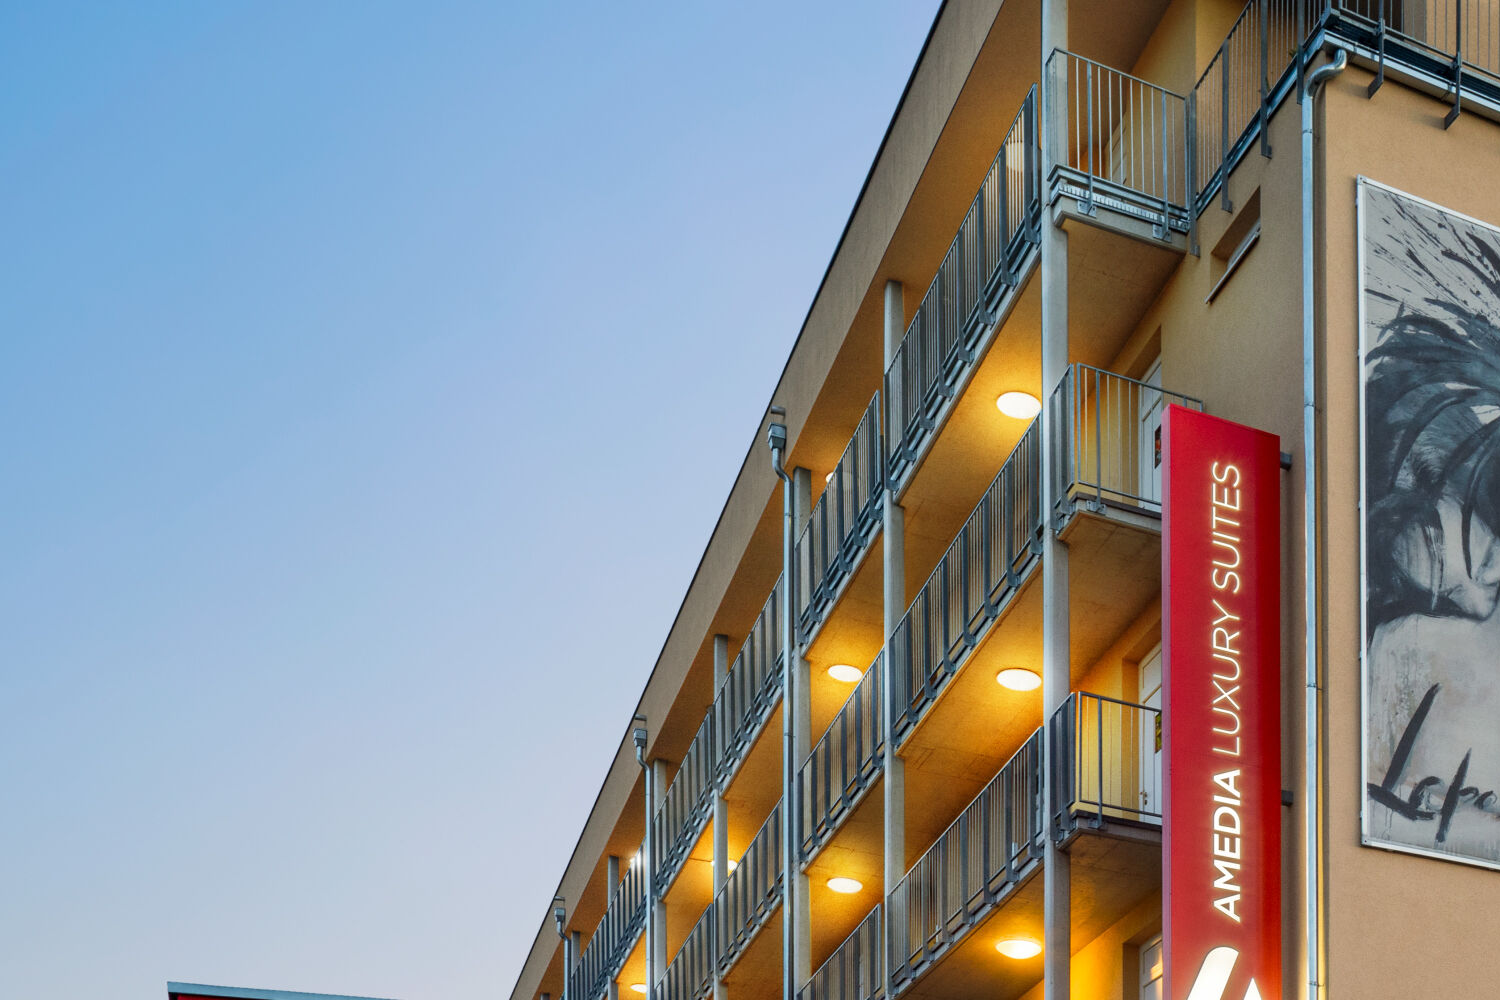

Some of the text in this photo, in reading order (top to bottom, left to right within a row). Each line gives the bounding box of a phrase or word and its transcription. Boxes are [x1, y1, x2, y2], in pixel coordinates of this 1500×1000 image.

[1210, 460, 1241, 924] AMEDIA LUXURY SUITES
